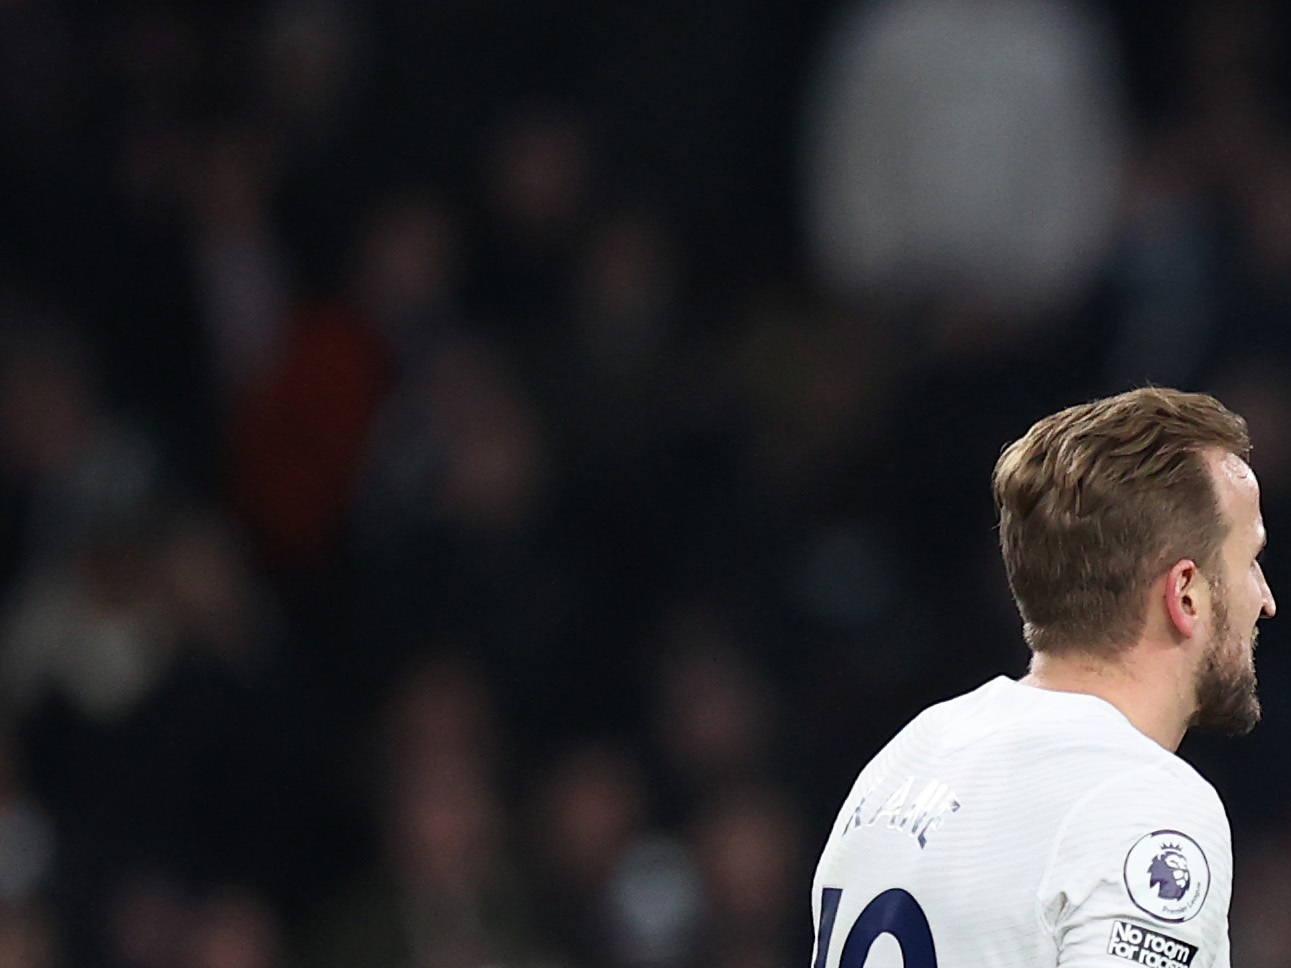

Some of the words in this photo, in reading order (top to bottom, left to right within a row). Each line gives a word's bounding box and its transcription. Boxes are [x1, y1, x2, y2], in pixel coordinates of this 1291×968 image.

[1108, 937, 1139, 960] for
[1111, 920, 1143, 945] No
[1143, 932, 1190, 963] room
